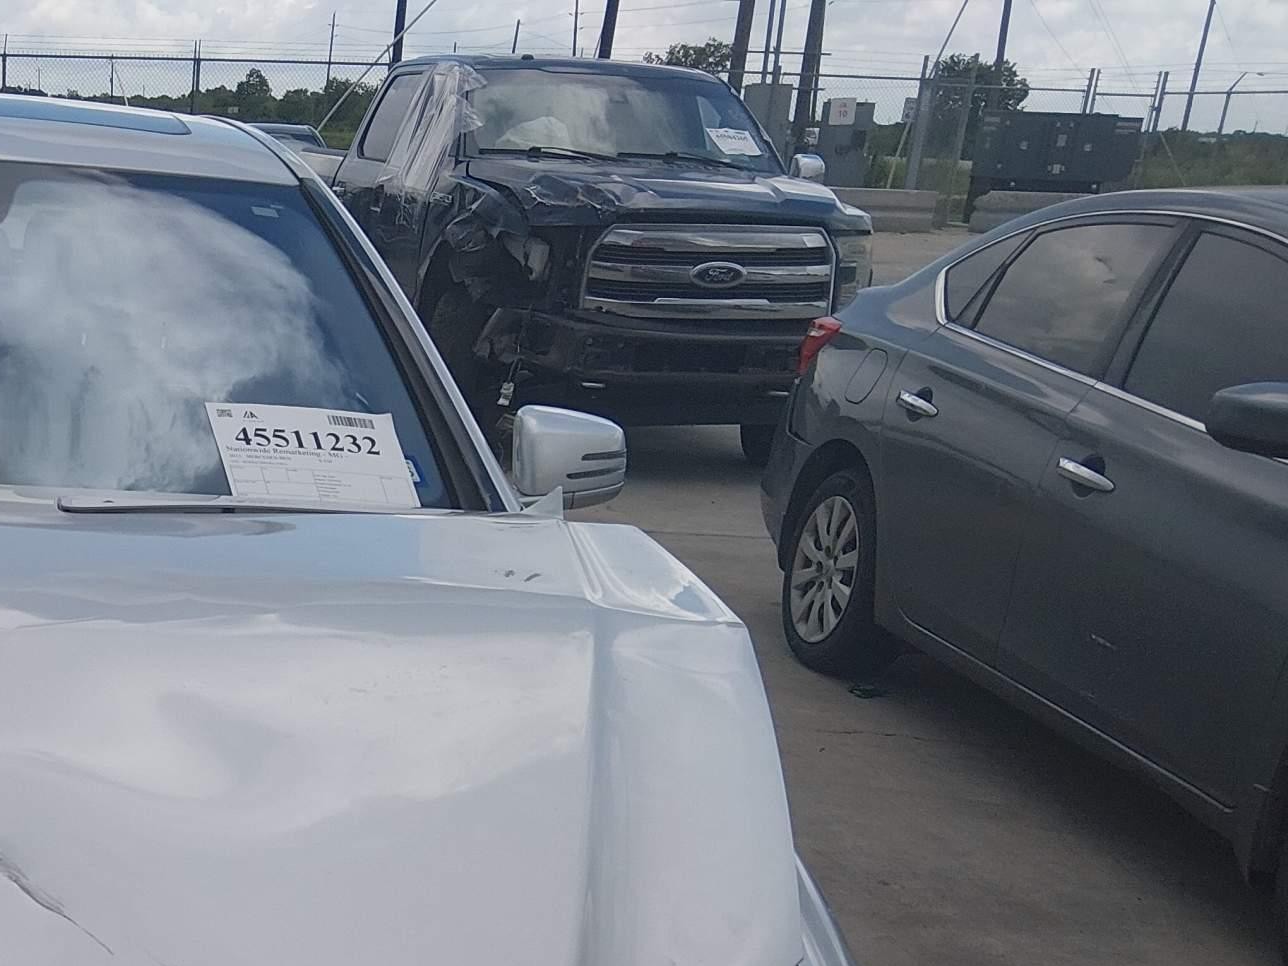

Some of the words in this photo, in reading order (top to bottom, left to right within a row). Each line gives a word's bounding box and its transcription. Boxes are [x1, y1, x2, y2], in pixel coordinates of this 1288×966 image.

[839, 110, 848, 119] 10
[235, 426, 381, 456] 45511232
[273, 446, 320, 457] Remarketing
